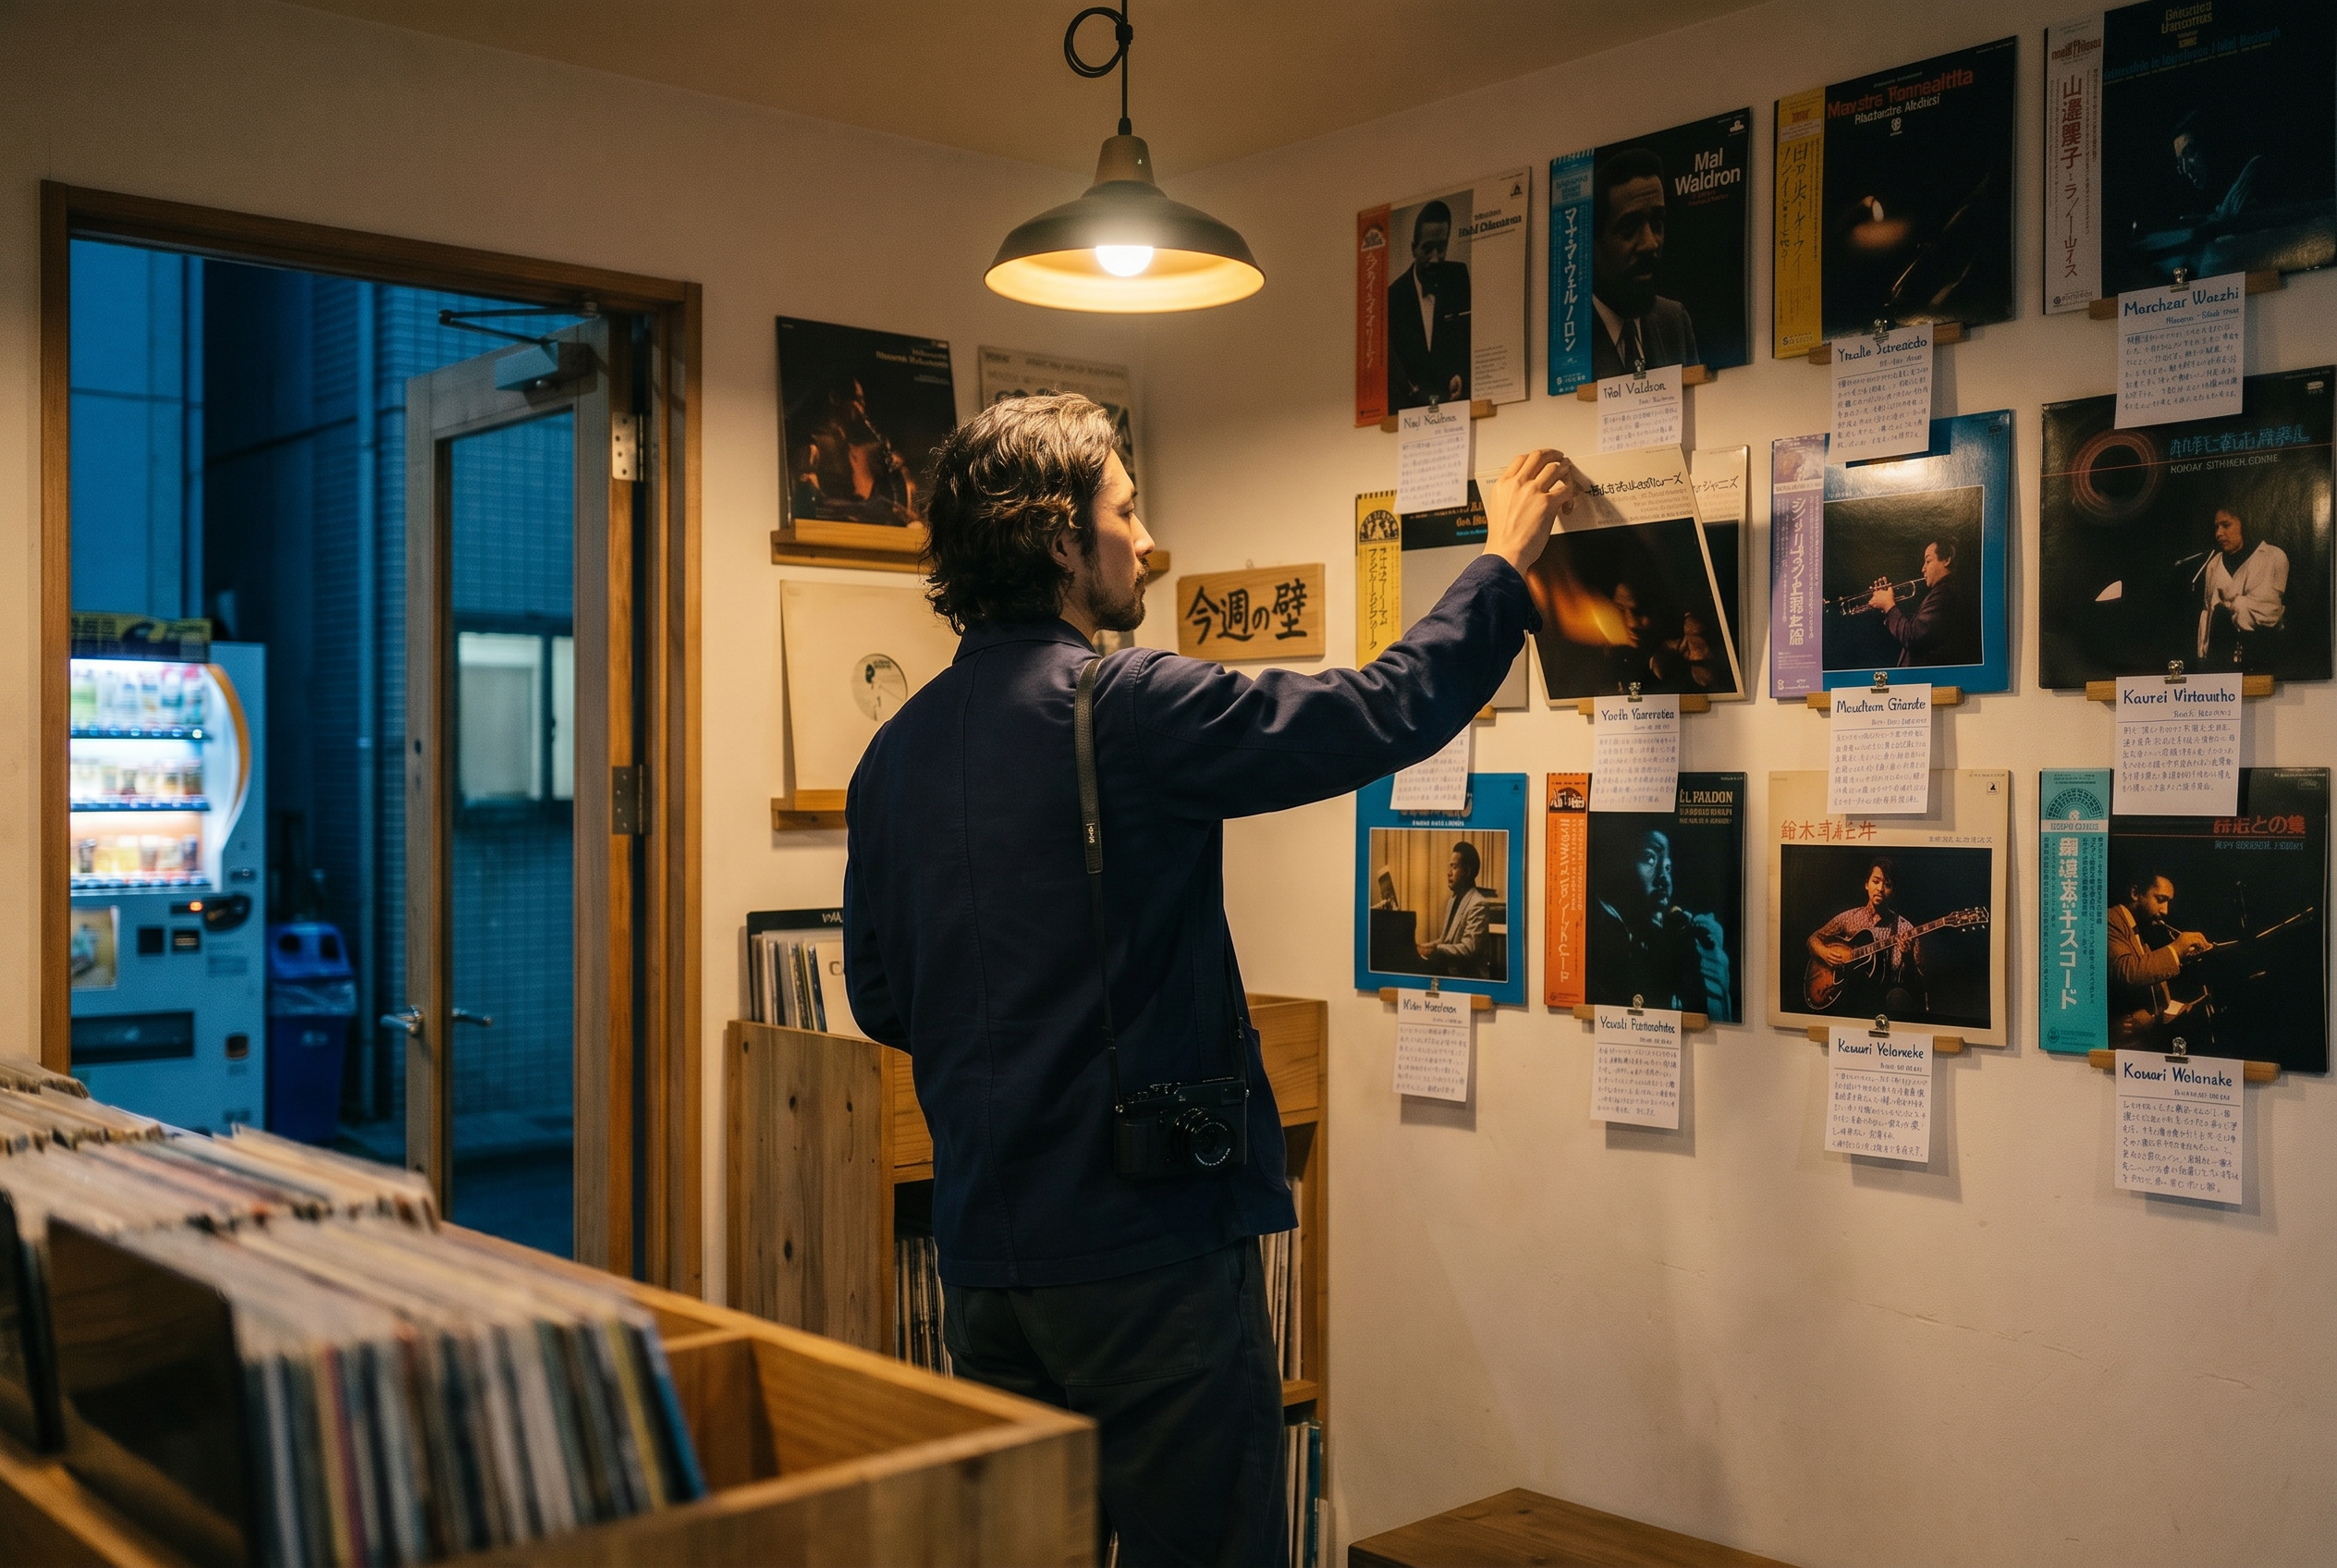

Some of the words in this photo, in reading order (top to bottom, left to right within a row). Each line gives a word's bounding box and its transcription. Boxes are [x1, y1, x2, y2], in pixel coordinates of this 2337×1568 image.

[1694, 147, 1723, 174] Mal
[1674, 165, 1741, 196] Waldron
[1185, 578, 1308, 645] 今週の壁
